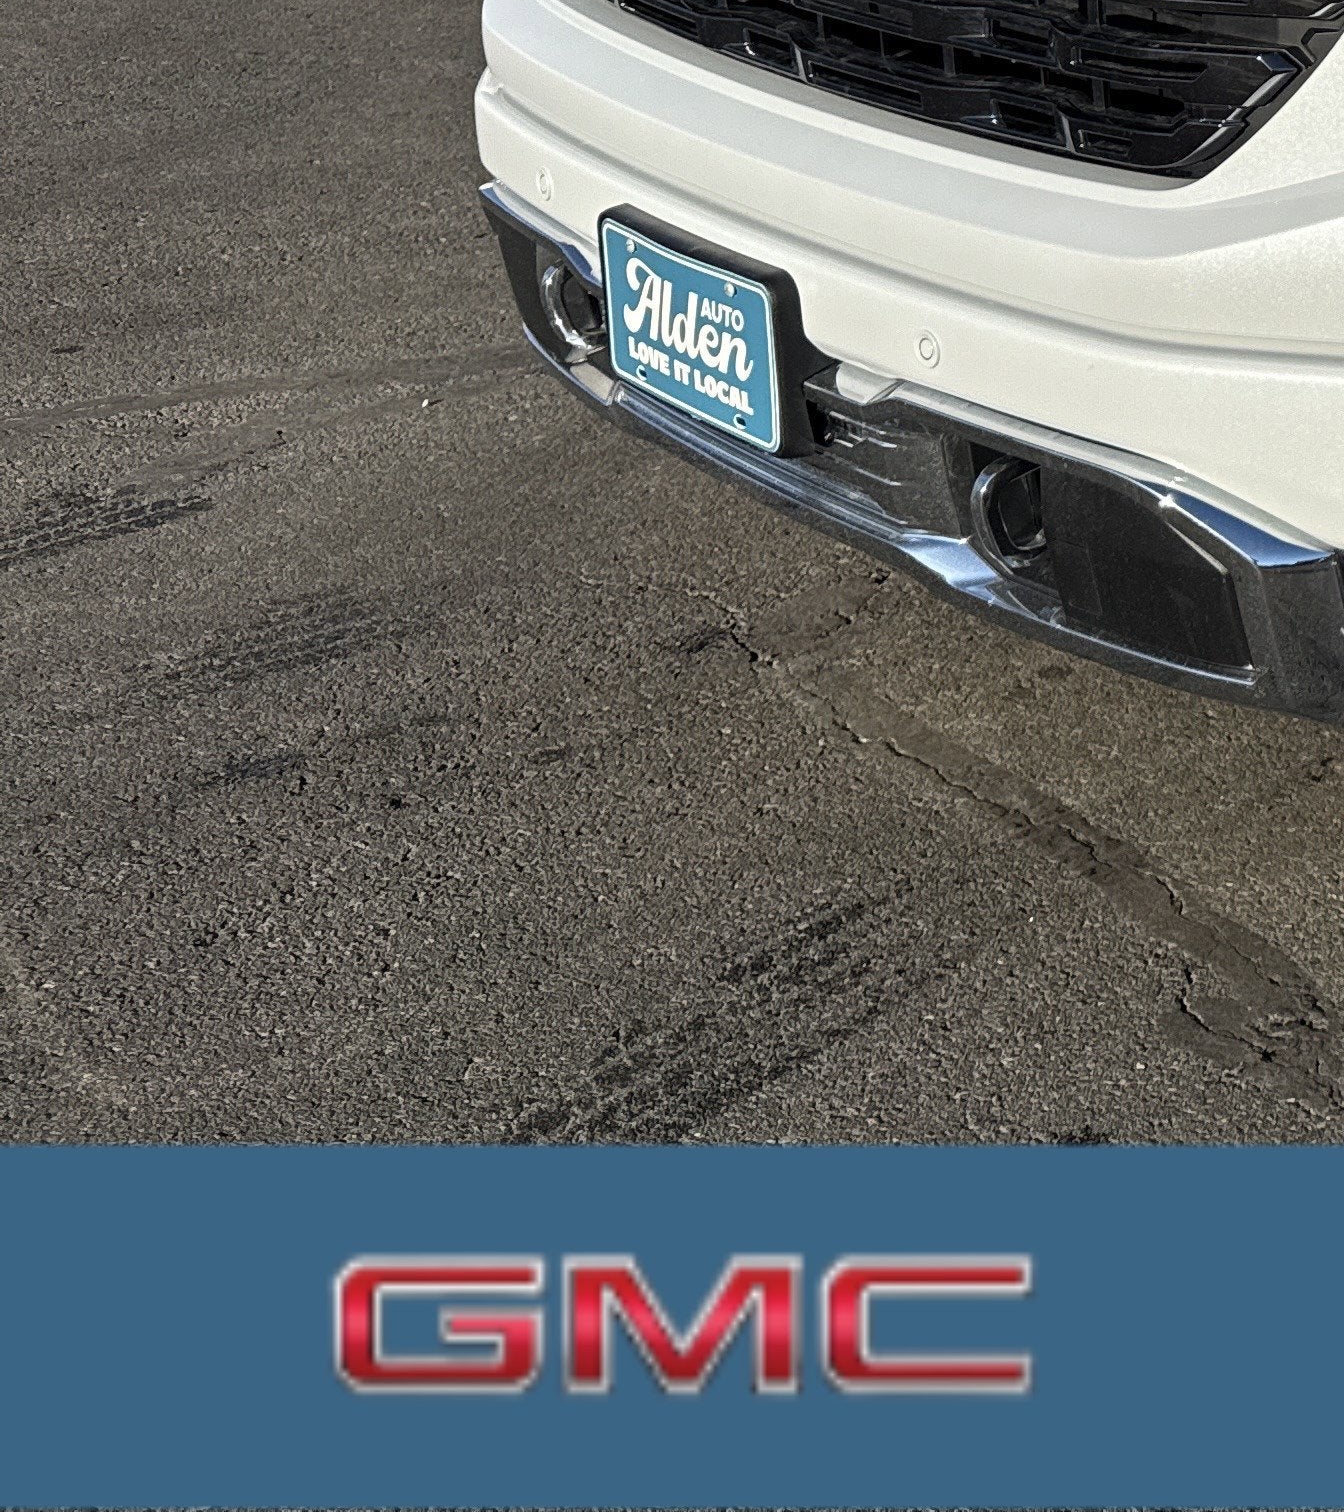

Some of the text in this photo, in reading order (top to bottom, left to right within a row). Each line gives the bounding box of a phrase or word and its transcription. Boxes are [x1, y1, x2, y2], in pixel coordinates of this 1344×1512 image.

[622, 256, 754, 382] Alden
[700, 297, 745, 333] AUTO
[627, 335, 755, 416] LOVE IT LOCAL
